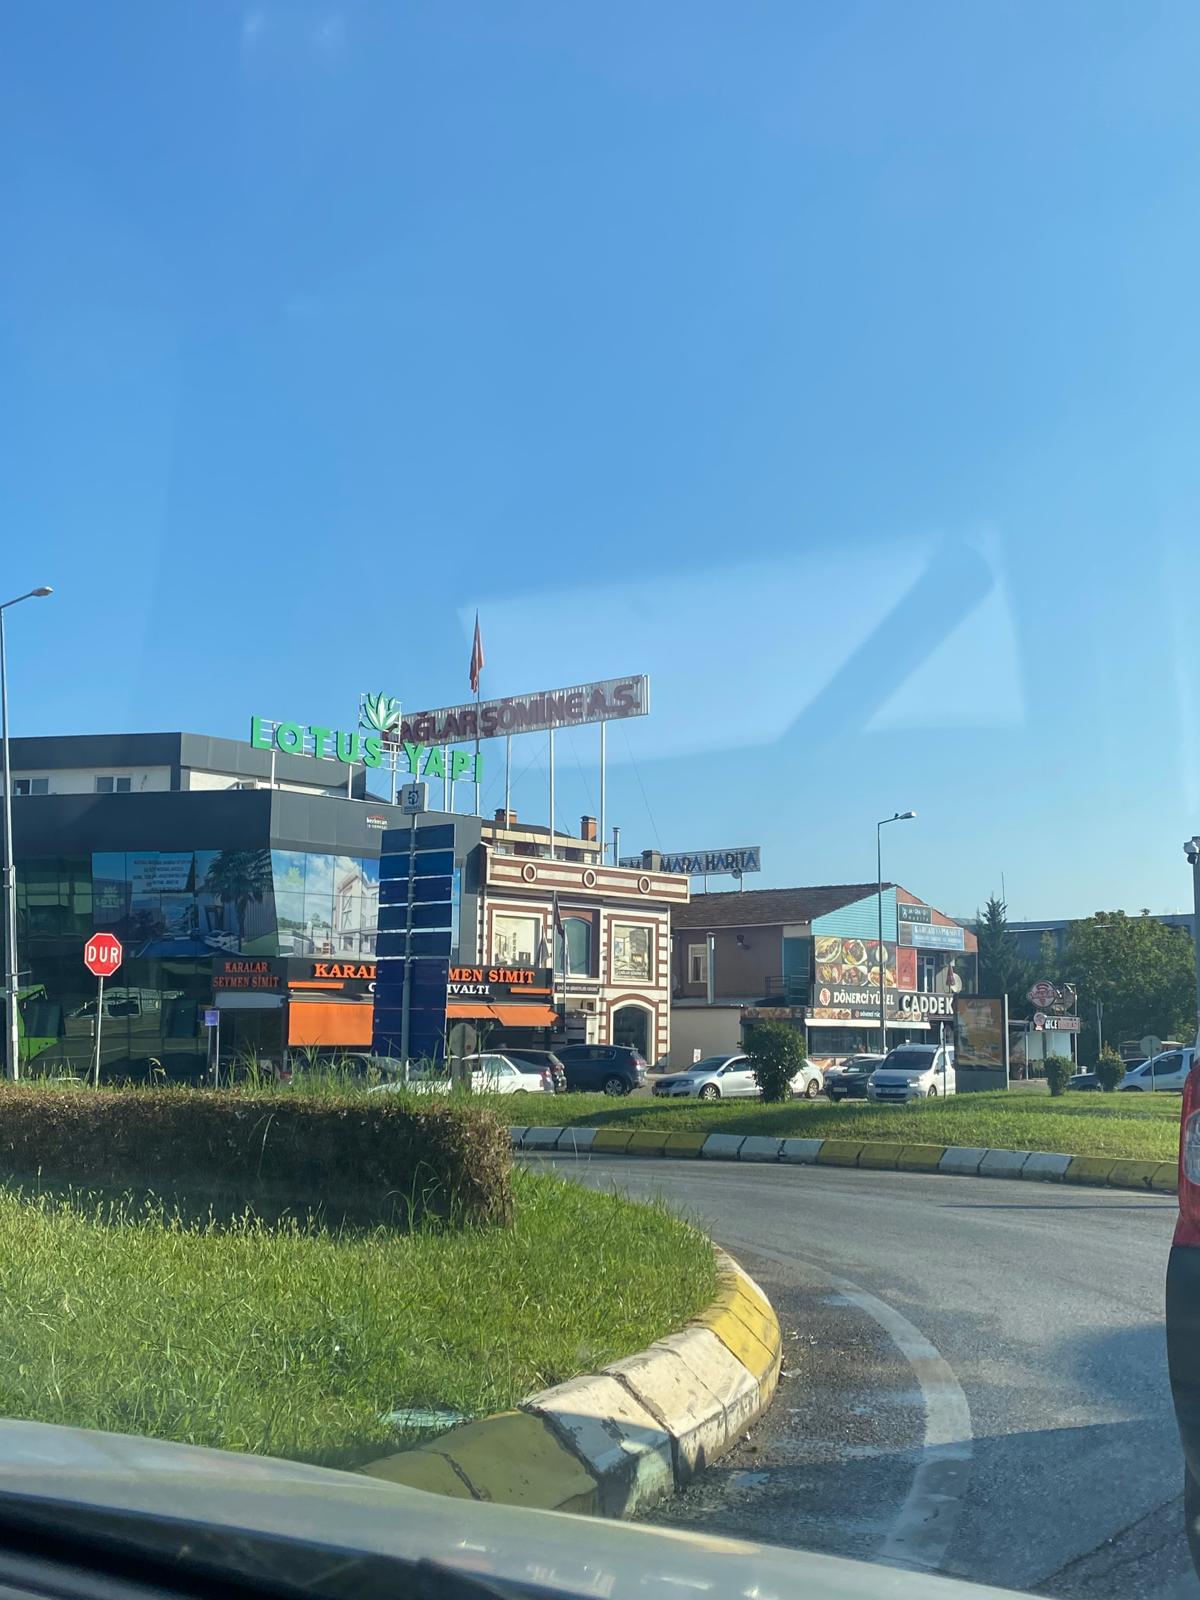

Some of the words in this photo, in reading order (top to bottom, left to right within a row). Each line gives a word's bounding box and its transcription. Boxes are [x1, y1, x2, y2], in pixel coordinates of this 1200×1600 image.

[480, 692, 584, 737] ŞÖMİNE
[251, 715, 383, 768] LOTUS
[402, 741, 483, 783] YAPI
[705, 850, 757, 871] HARİTA
[88, 945, 119, 964] DUR
[225, 962, 268, 973] KARALAR
[314, 963, 377, 979] KARAL
[448, 968, 484, 982] MEN
[489, 967, 536, 984] SİMİT
[213, 976, 249, 988] SEYMEN
[252, 974, 279, 988] SİMİT
[833, 989, 869, 1004] DÖNERCİ
[870, 990, 895, 1006] YÜEL
